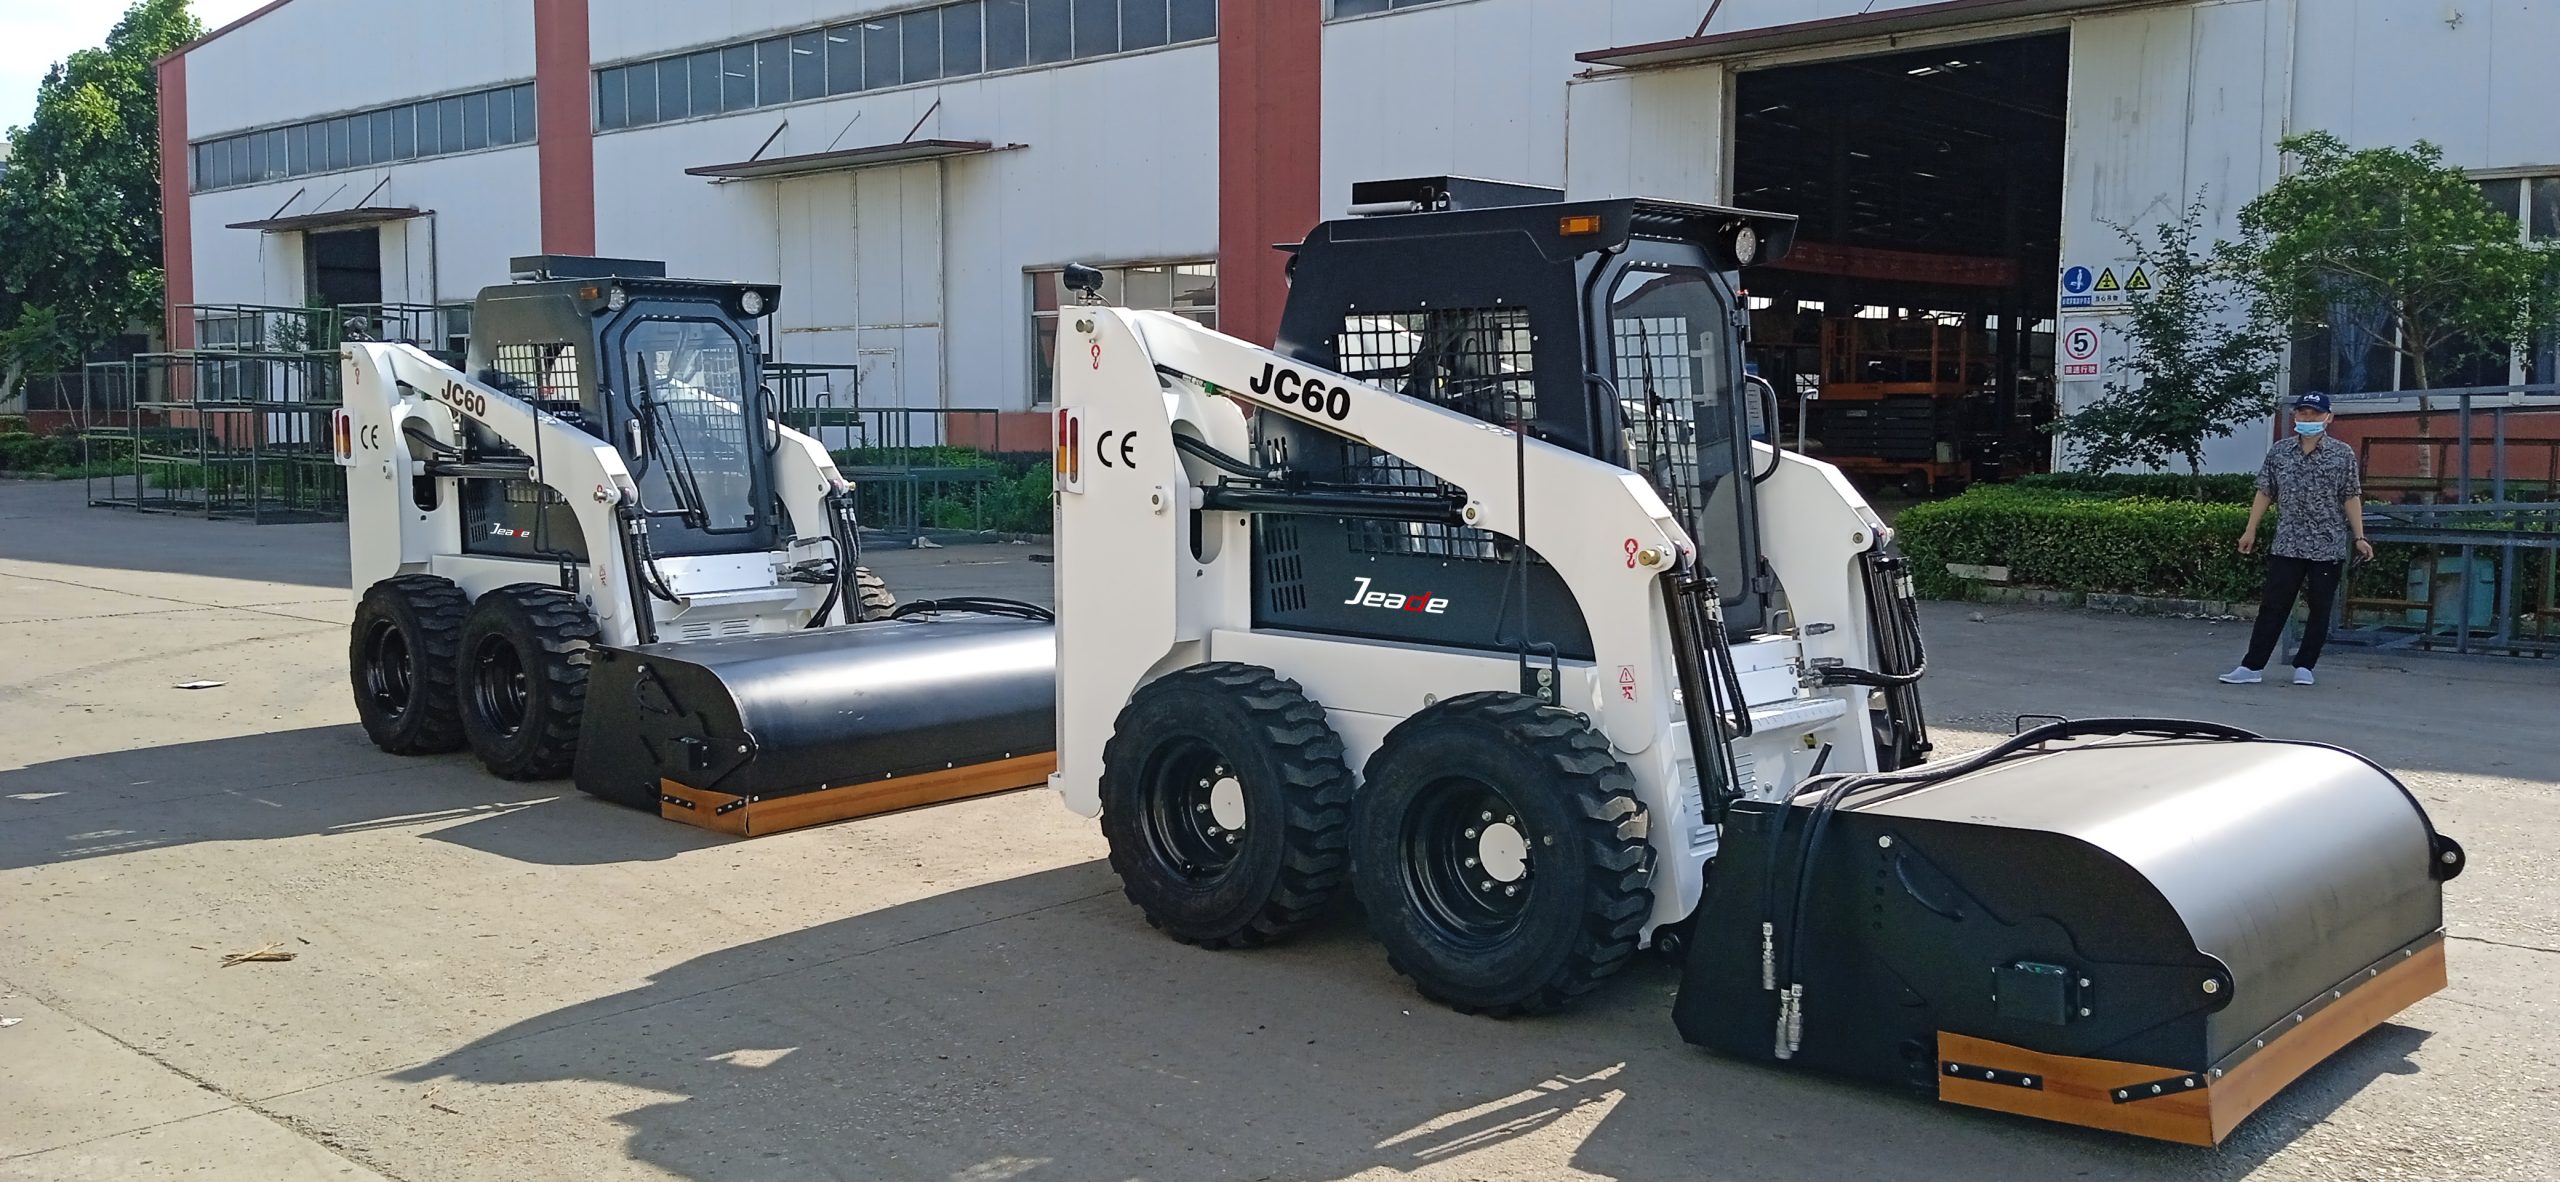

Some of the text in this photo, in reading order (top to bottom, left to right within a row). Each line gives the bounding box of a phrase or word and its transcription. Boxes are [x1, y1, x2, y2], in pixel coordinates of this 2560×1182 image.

[2074, 332, 2089, 352] 5
[441, 379, 486, 418] JC60
[1250, 362, 1351, 421] JC60
[360, 424, 379, 450] CE
[1096, 430, 1138, 469] CE
[489, 522, 531, 538] Jeade
[1344, 576, 1449, 615] Jeade
